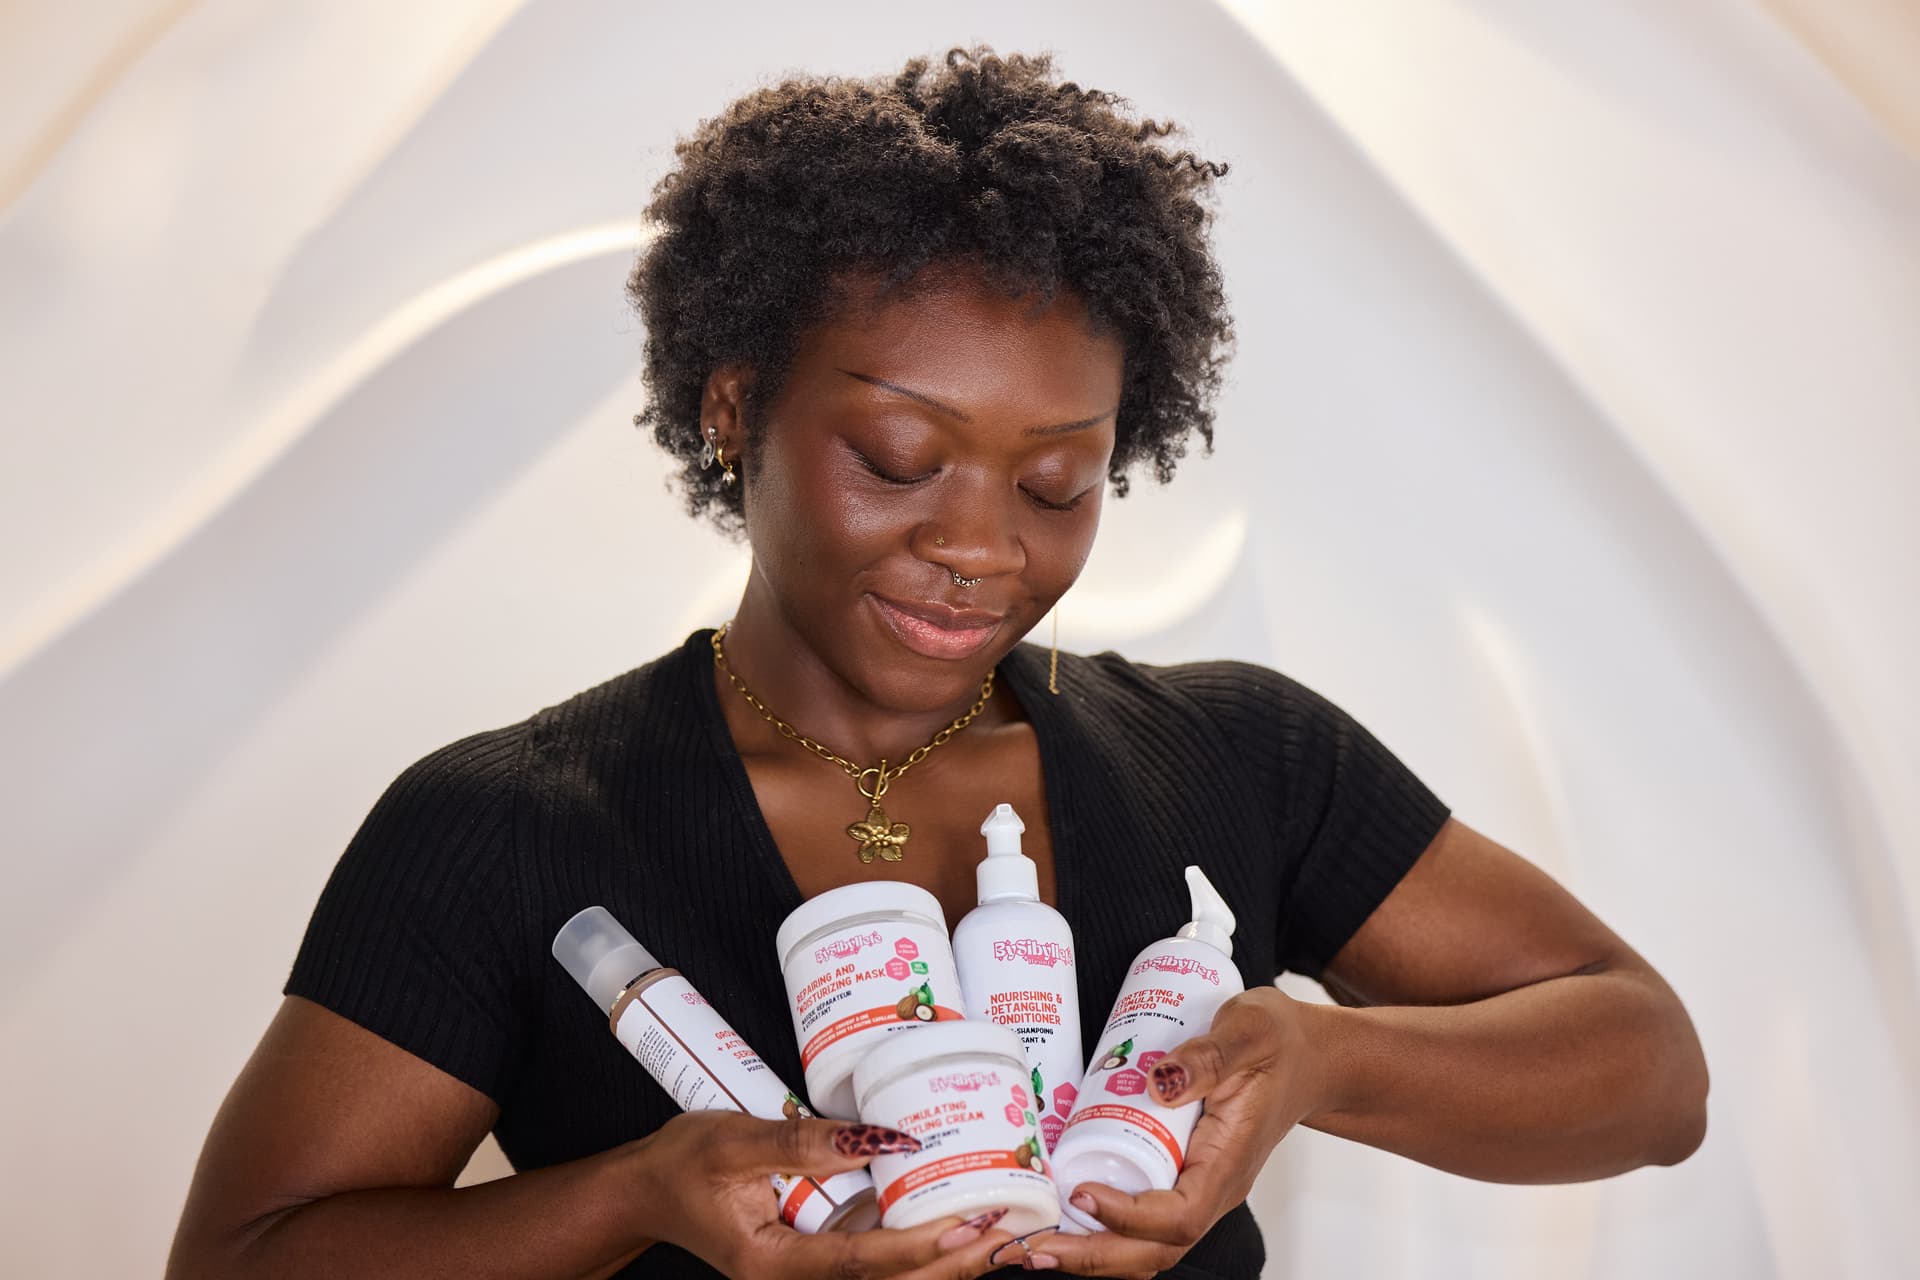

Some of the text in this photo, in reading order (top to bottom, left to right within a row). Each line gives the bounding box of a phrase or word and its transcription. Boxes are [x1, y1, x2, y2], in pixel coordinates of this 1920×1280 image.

[856, 968, 886, 984] MASK
[796, 963, 855, 1003] REPAIRING AND
[990, 991, 1063, 1004] NOURISHING &
[1176, 993, 1184, 1001] &
[991, 1002, 1057, 1015] DETANGLING
[992, 1013, 1061, 1025] CONDITIONER
[897, 1101, 967, 1129] STIMULATING
[946, 1111, 984, 1125] CREAM
